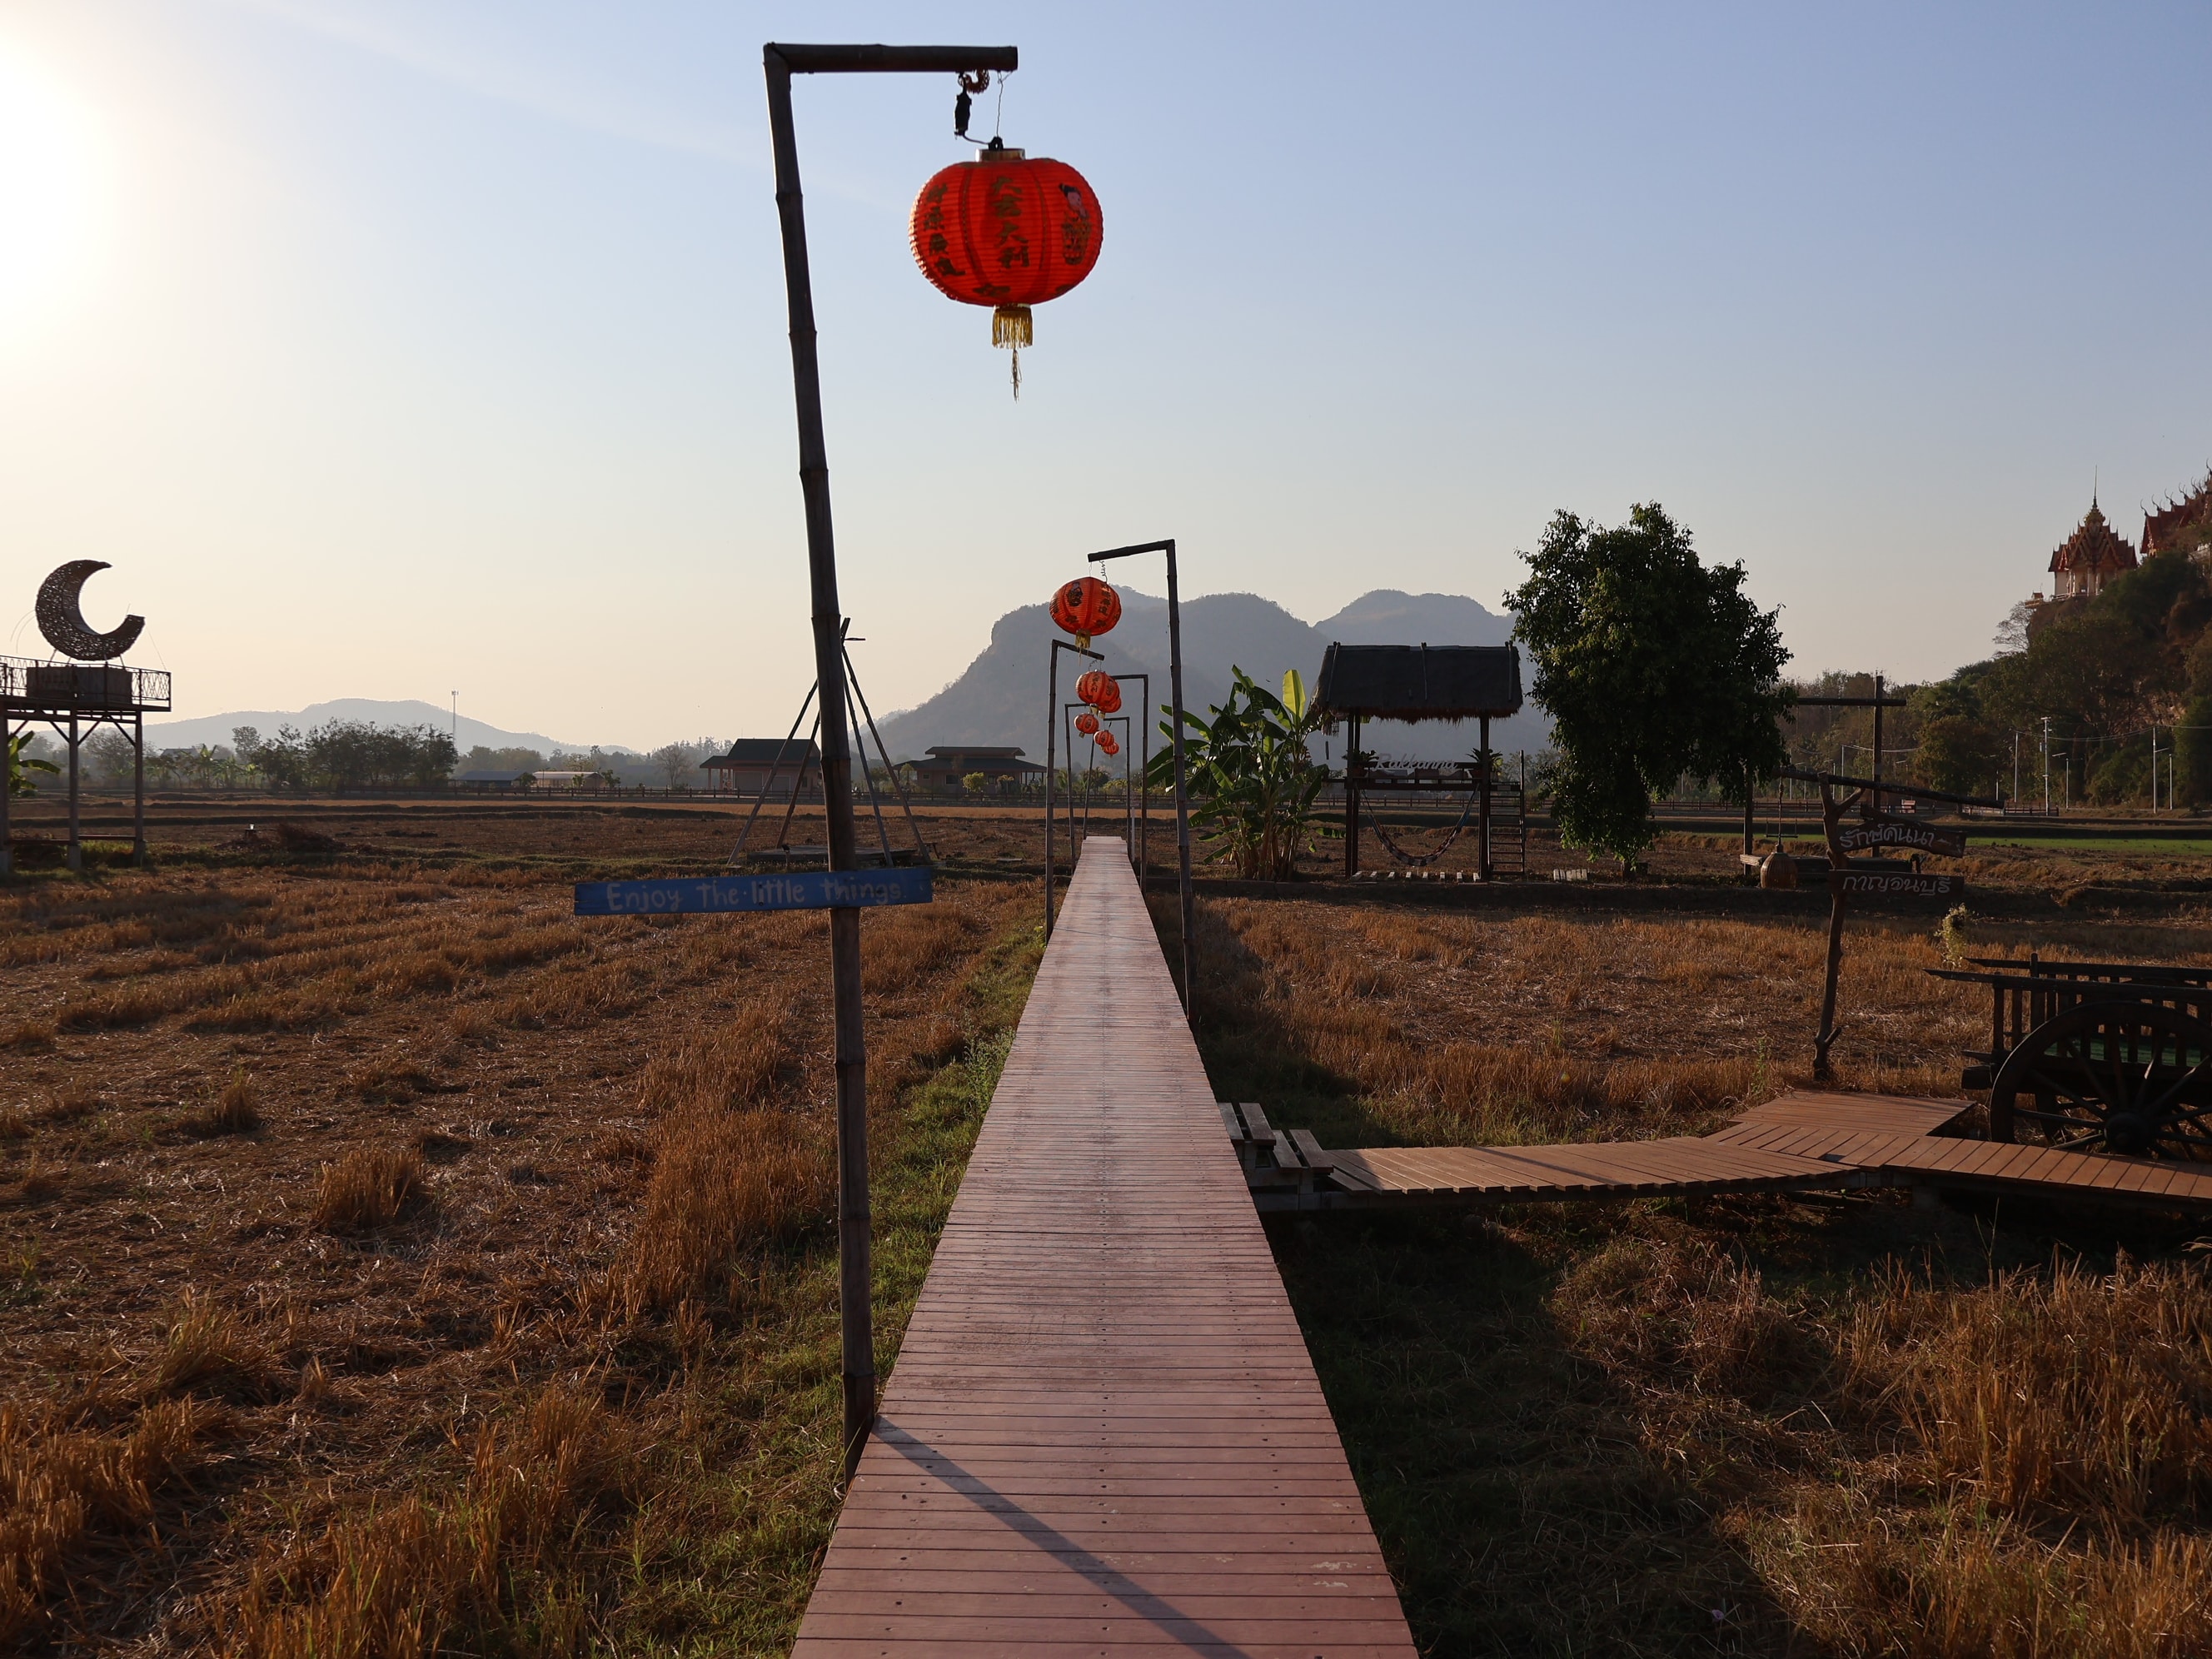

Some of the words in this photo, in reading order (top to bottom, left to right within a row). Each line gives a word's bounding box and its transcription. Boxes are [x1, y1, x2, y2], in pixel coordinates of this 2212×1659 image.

[606, 882, 684, 912] Enjoy
[696, 879, 740, 908] The
[751, 877, 805, 905] little
[1842, 875, 1952, 897] กาญจนบุรี
